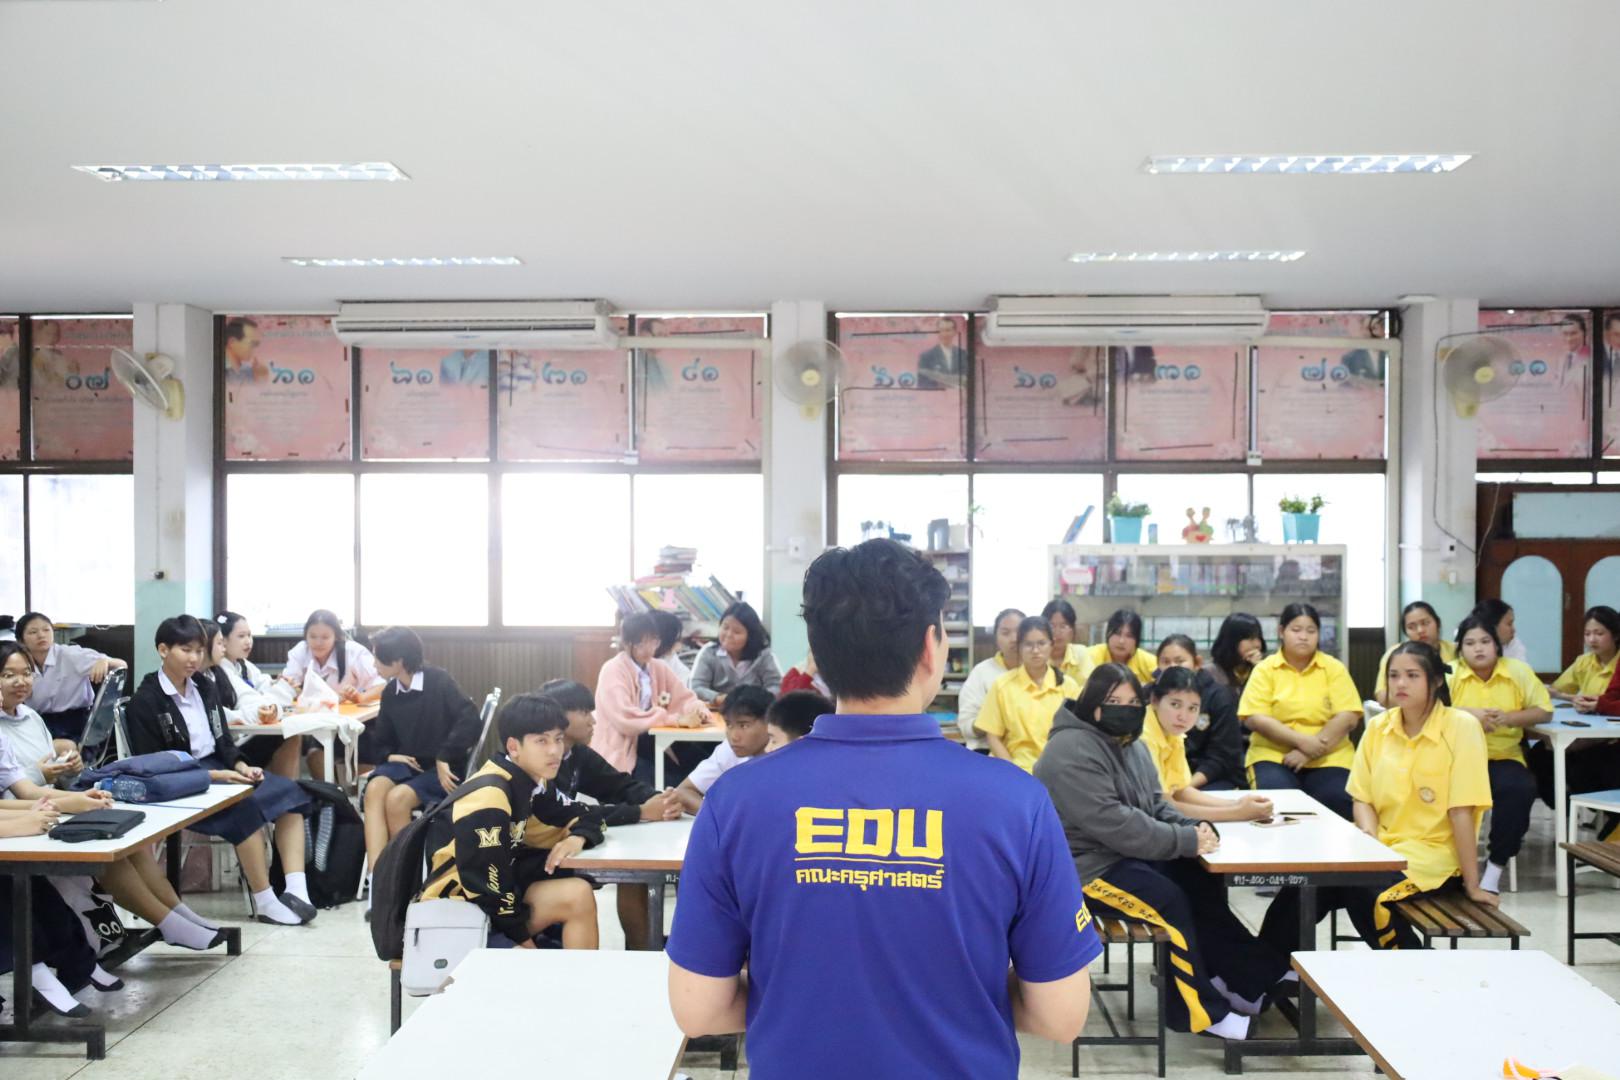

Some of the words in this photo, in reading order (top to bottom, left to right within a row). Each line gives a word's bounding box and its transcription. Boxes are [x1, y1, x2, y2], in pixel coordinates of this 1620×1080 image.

[474, 826, 502, 849] M
[794, 807, 944, 860] EDU
[795, 868, 945, 891] คณะครุศาสตร์
